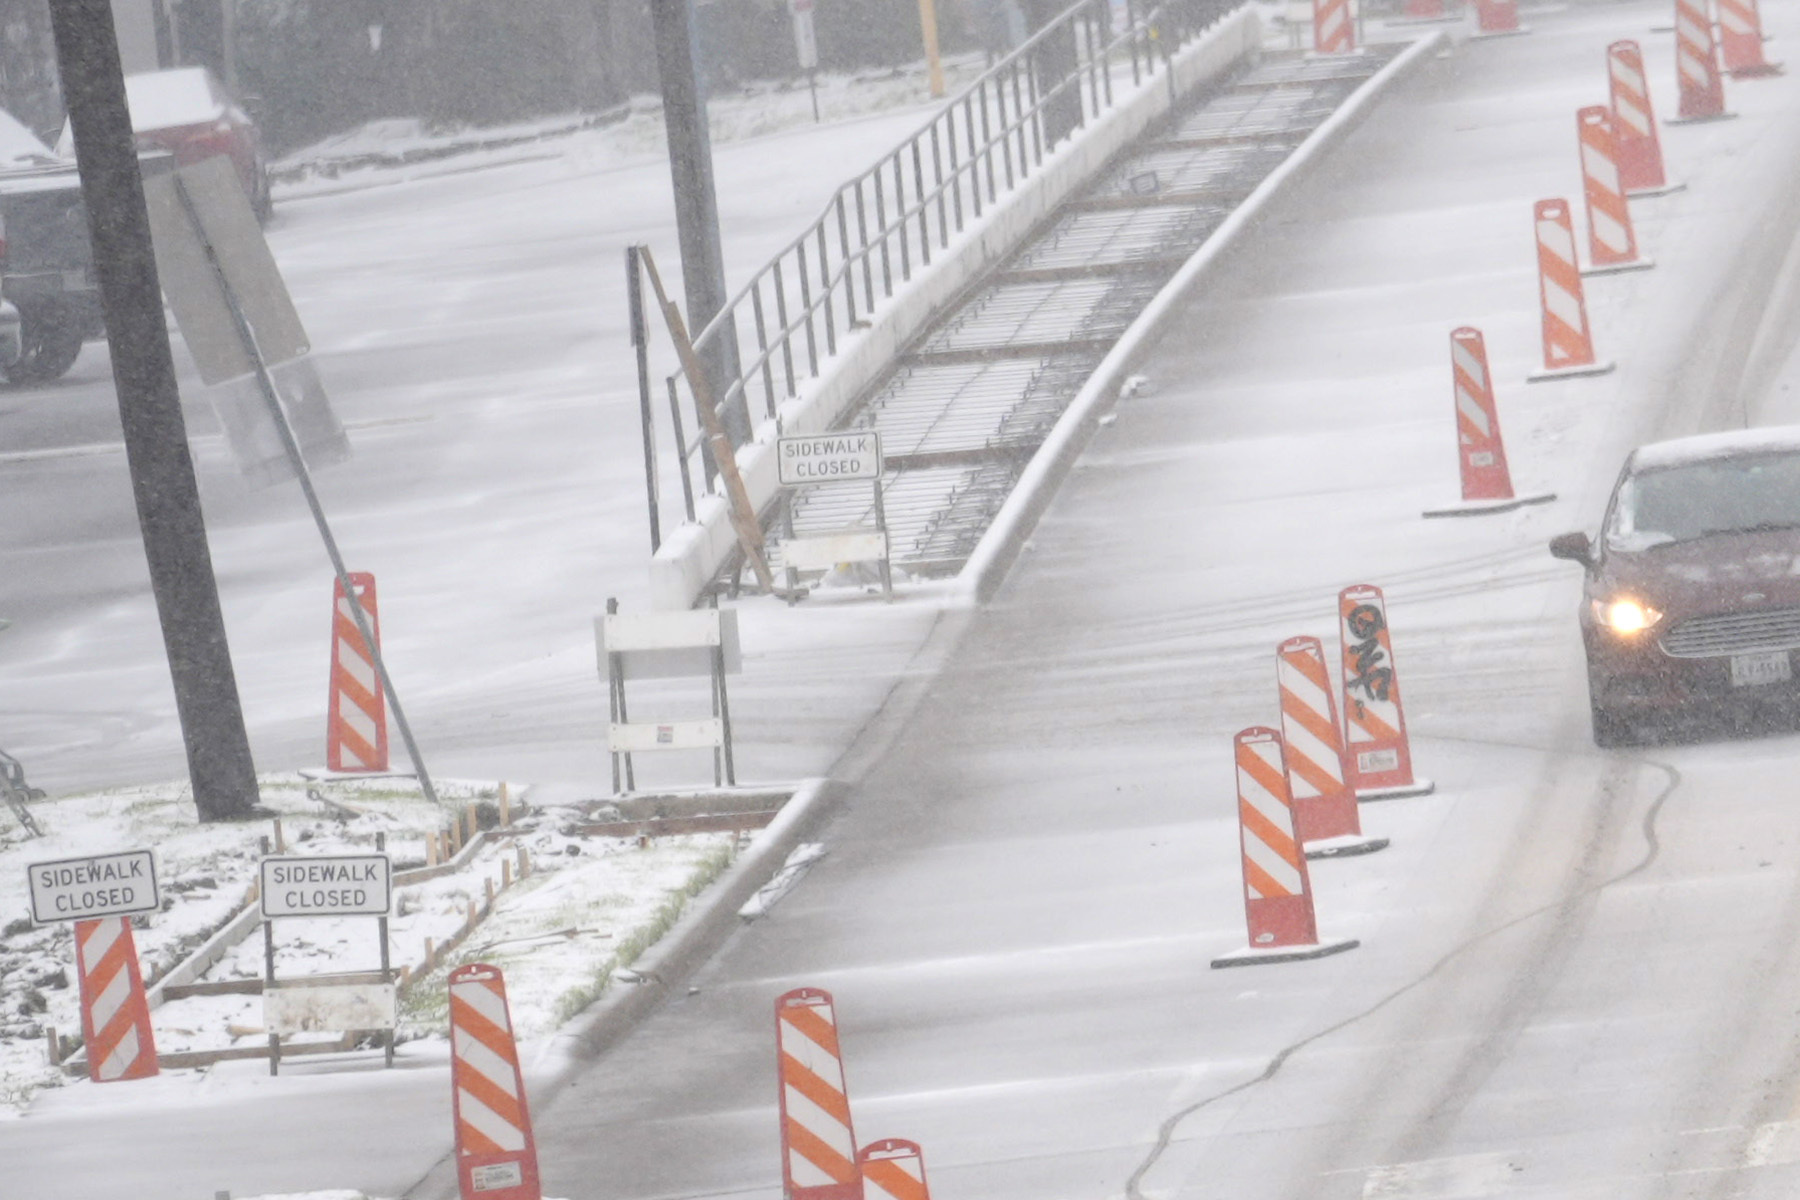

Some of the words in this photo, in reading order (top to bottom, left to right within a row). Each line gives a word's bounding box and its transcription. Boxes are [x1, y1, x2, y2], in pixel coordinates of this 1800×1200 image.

[786, 438, 866, 458] SIDEWALK
[797, 460, 861, 477] CLOSED
[41, 860, 142, 888] SIDEWALK
[273, 864, 377, 884] SIDEWALK
[55, 887, 134, 912] CLOSED
[285, 889, 366, 908] CLOSED
